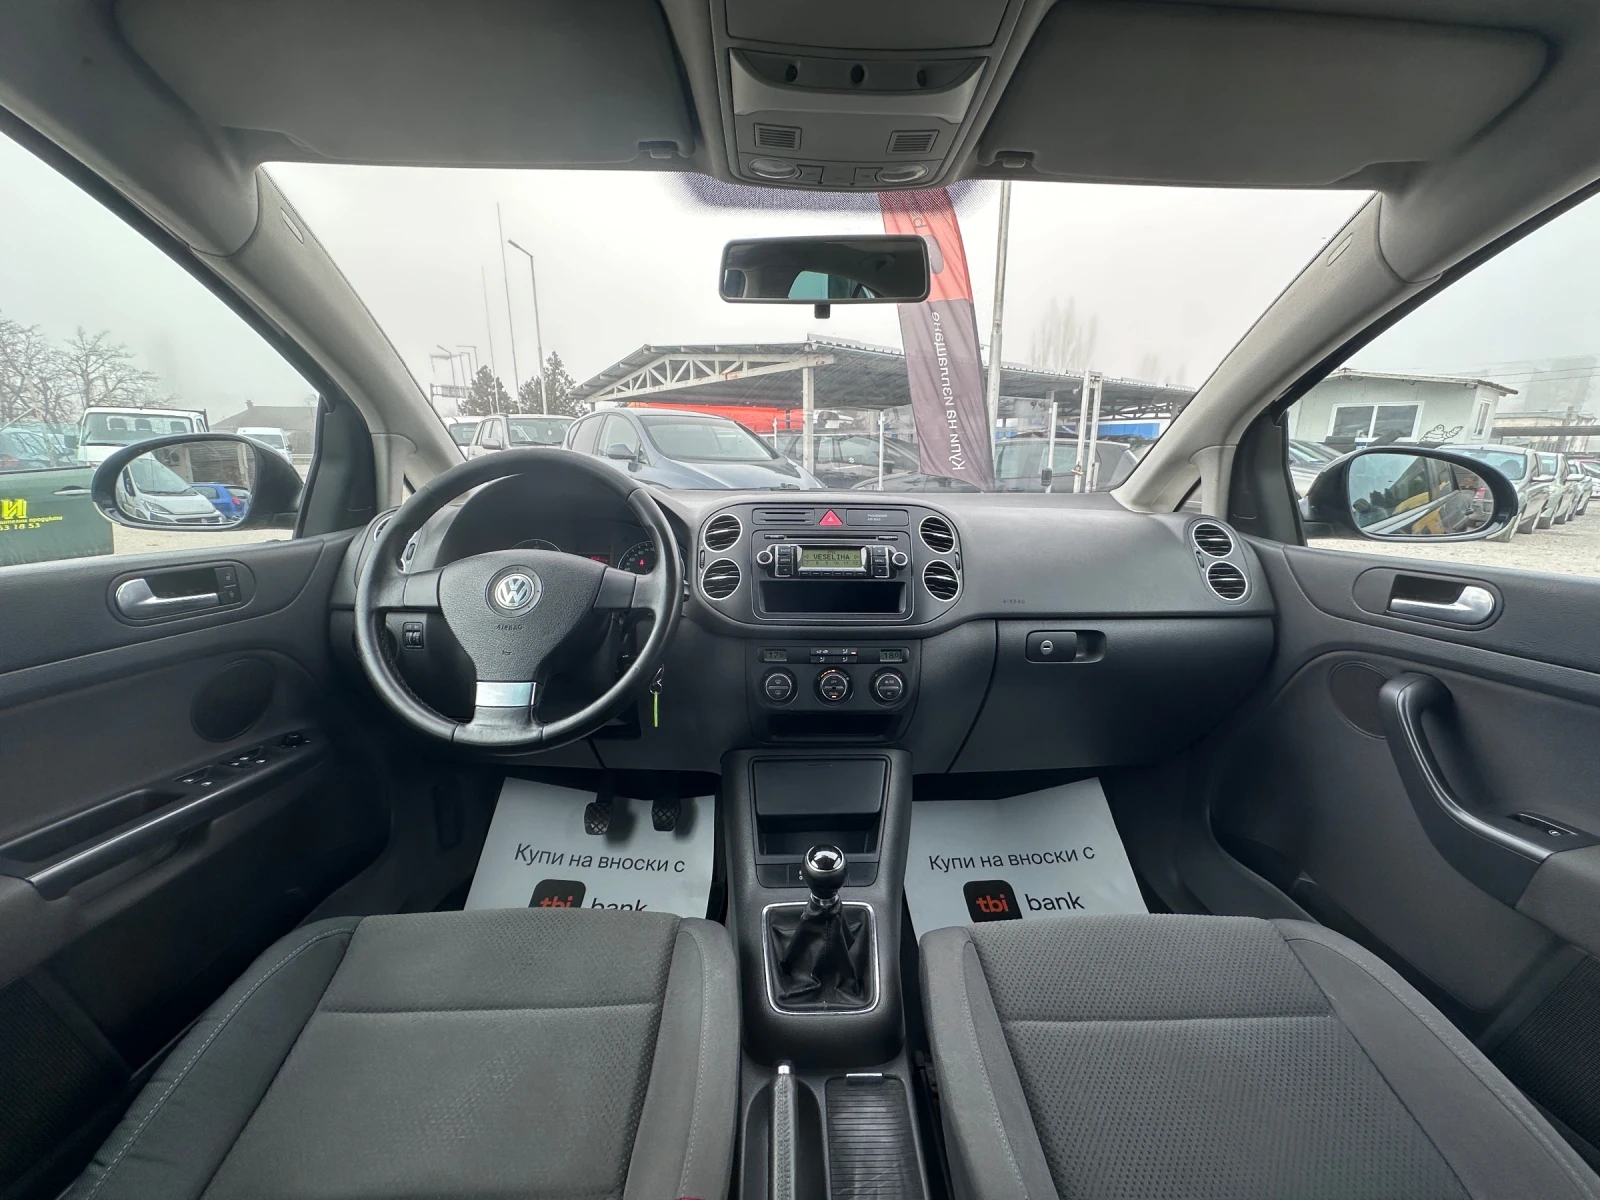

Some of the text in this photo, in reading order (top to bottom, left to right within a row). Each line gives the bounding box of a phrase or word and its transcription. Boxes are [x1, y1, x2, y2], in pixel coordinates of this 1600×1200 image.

[497, 575, 532, 607] VW
[514, 843, 686, 873] Купи на вноски с
[929, 846, 1095, 873] Купи на вноски с
[975, 891, 1086, 913] tbi bank
